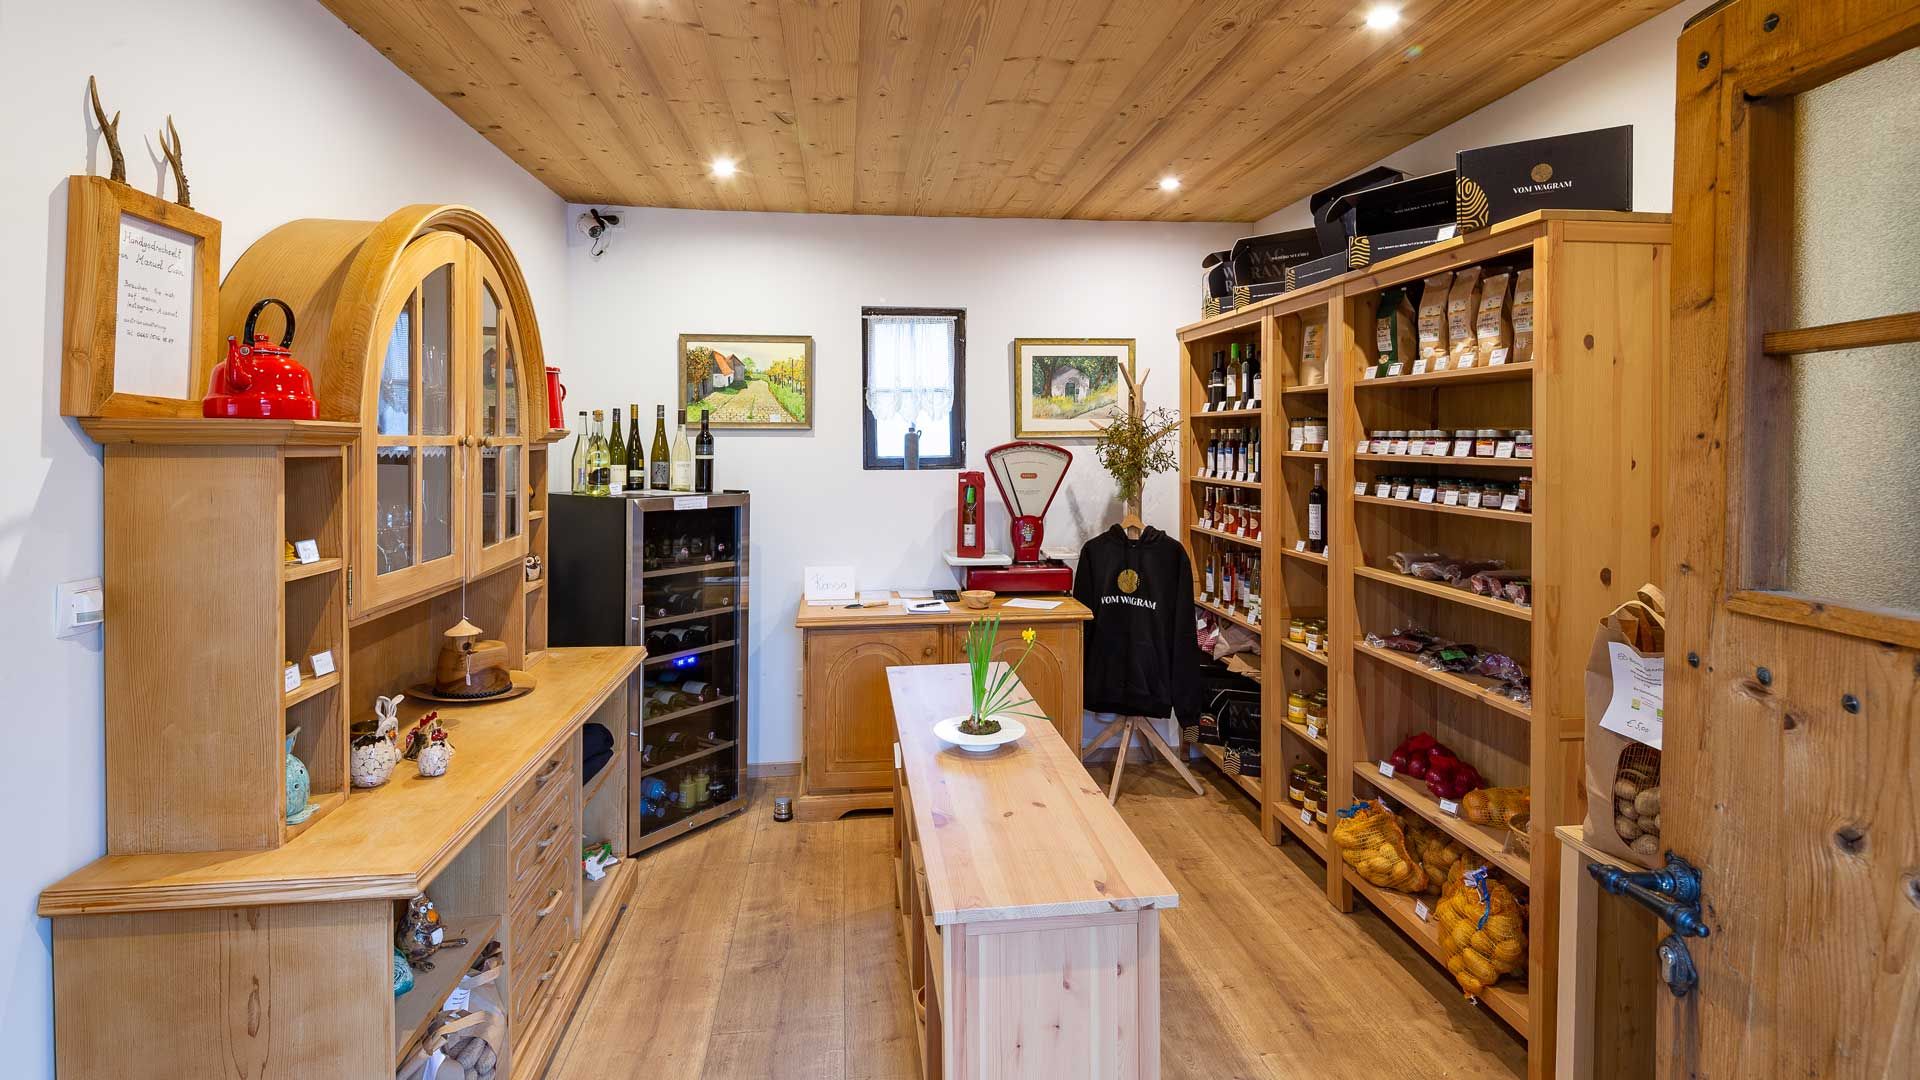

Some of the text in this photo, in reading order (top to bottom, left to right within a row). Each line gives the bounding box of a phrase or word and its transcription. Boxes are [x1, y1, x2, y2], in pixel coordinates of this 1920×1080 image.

[1513, 181, 1572, 194] VOM WAGRAM
[1101, 596, 1119, 604] VOM
